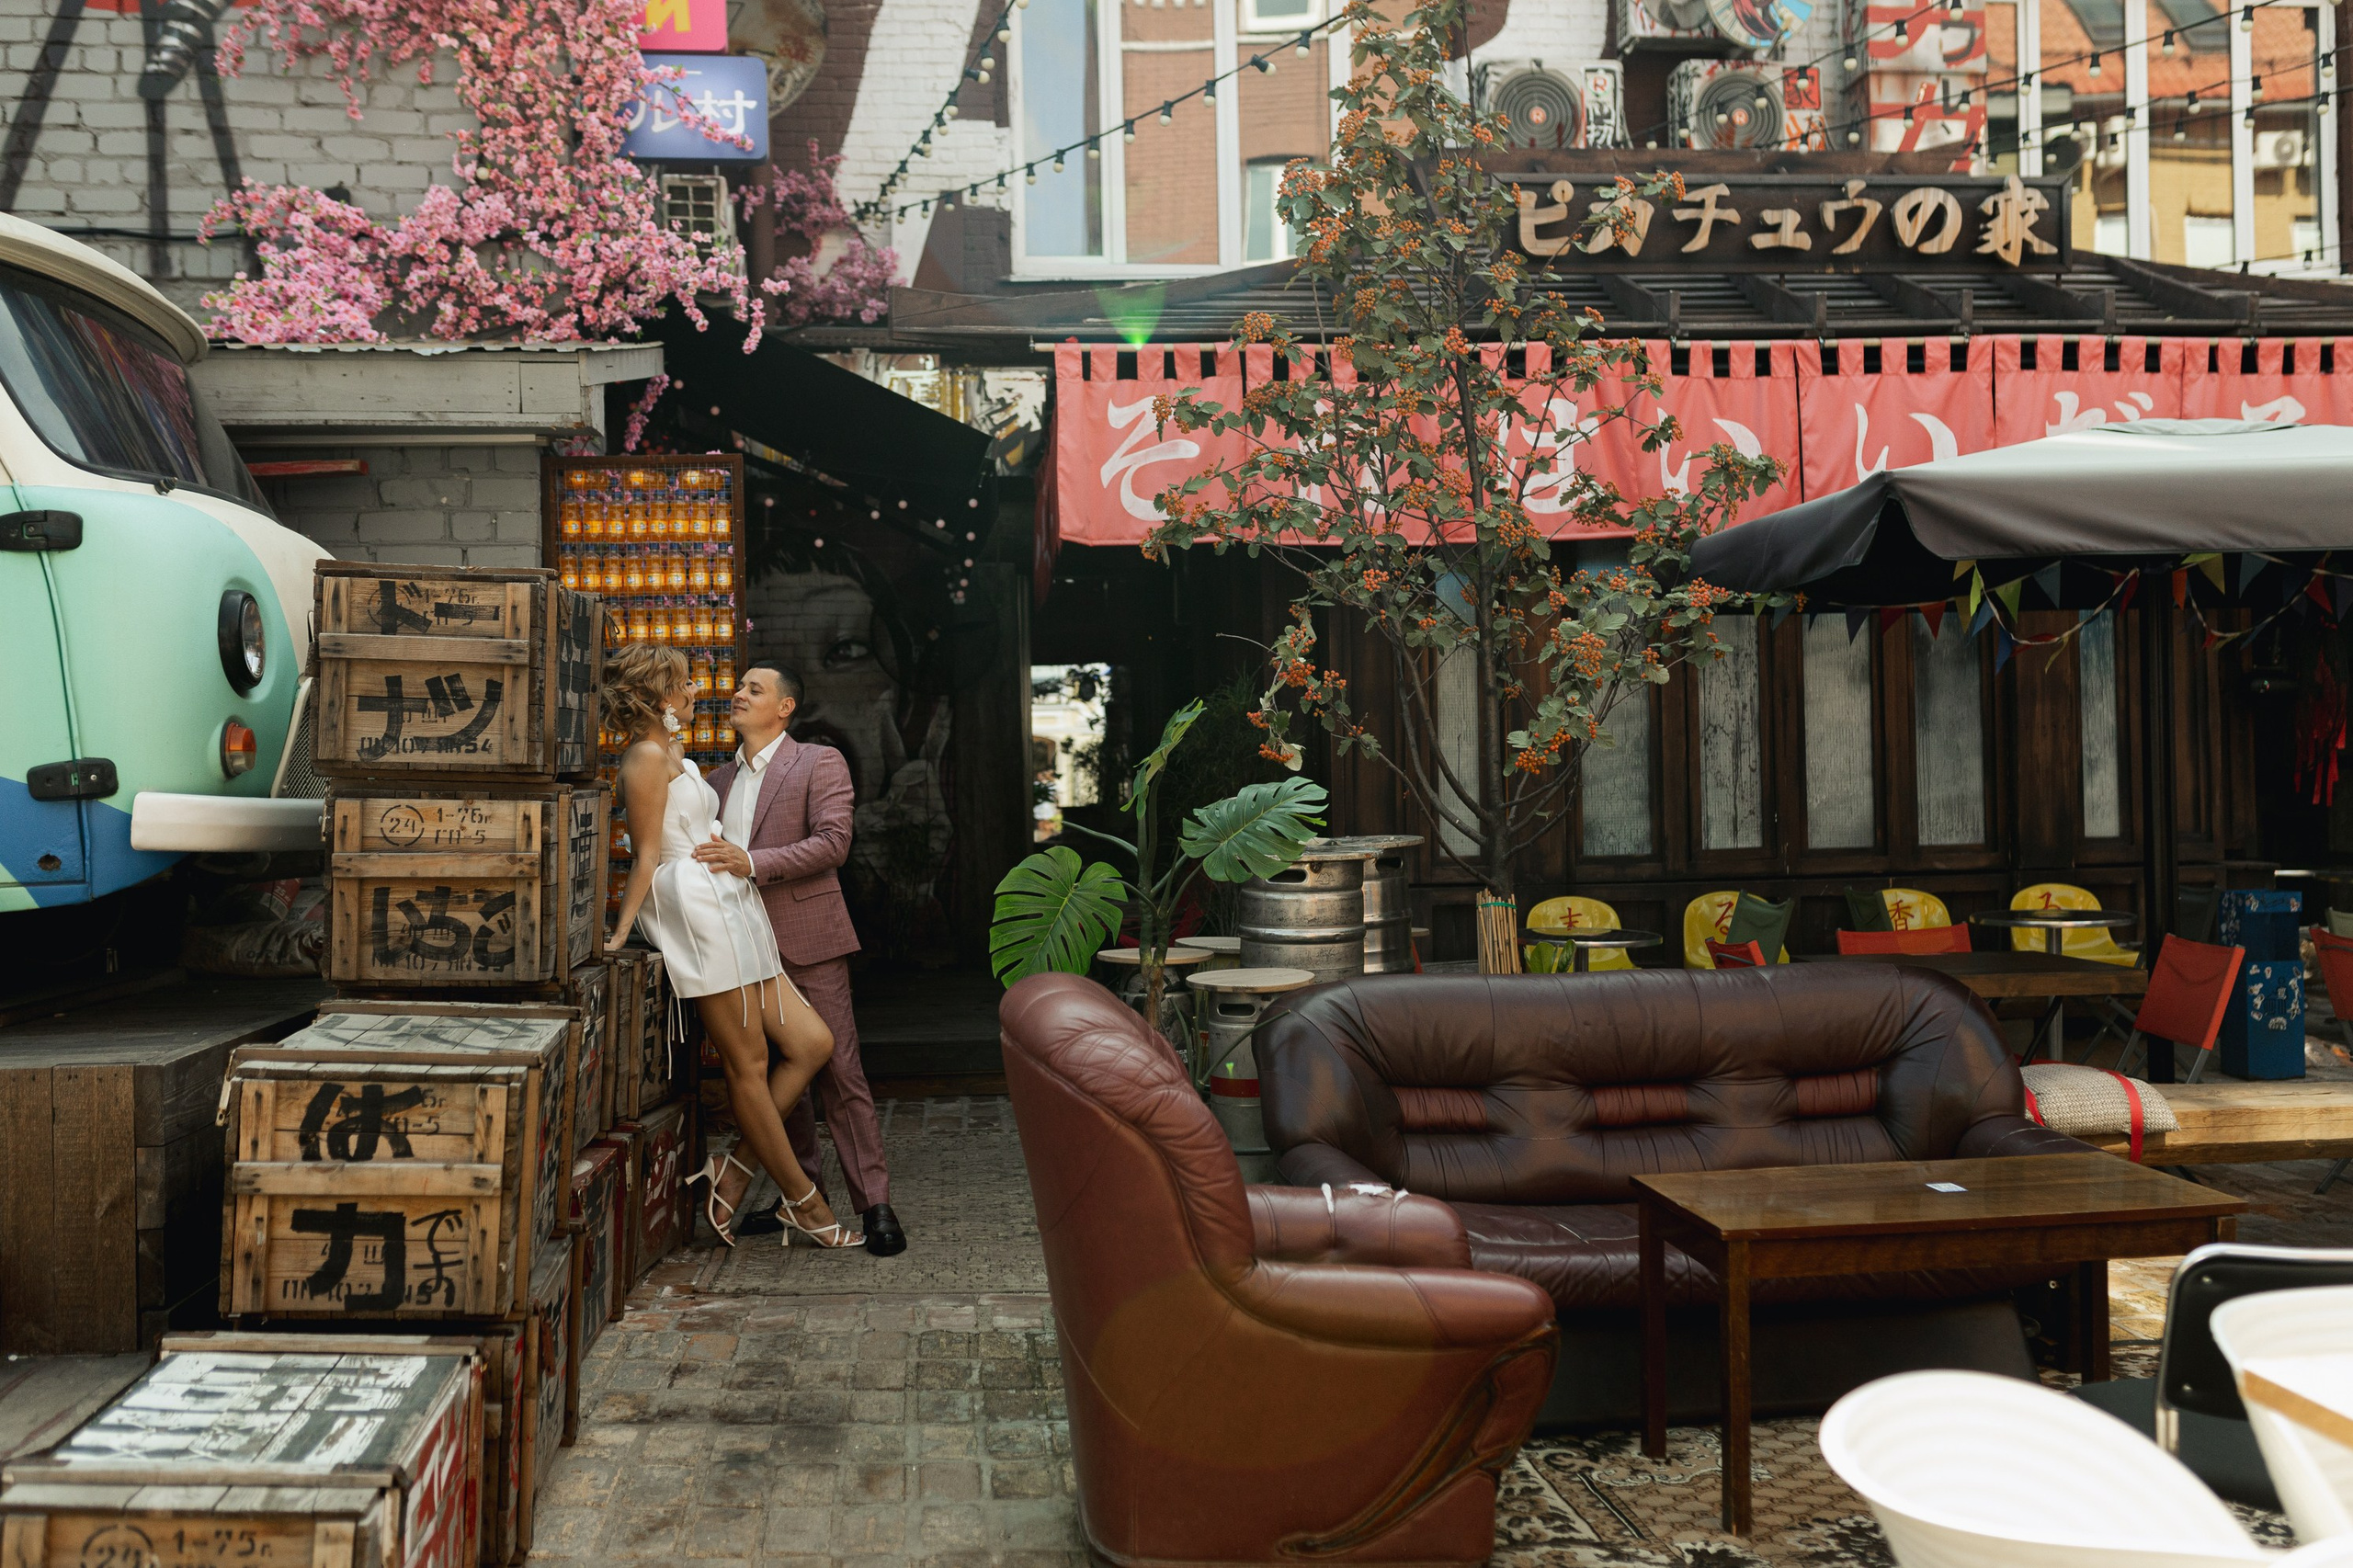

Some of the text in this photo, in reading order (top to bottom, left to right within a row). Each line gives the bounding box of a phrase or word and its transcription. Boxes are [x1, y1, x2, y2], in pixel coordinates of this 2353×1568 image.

[1517, 175, 2059, 267] ピカチュウの家
[389, 817, 416, 834] 24
